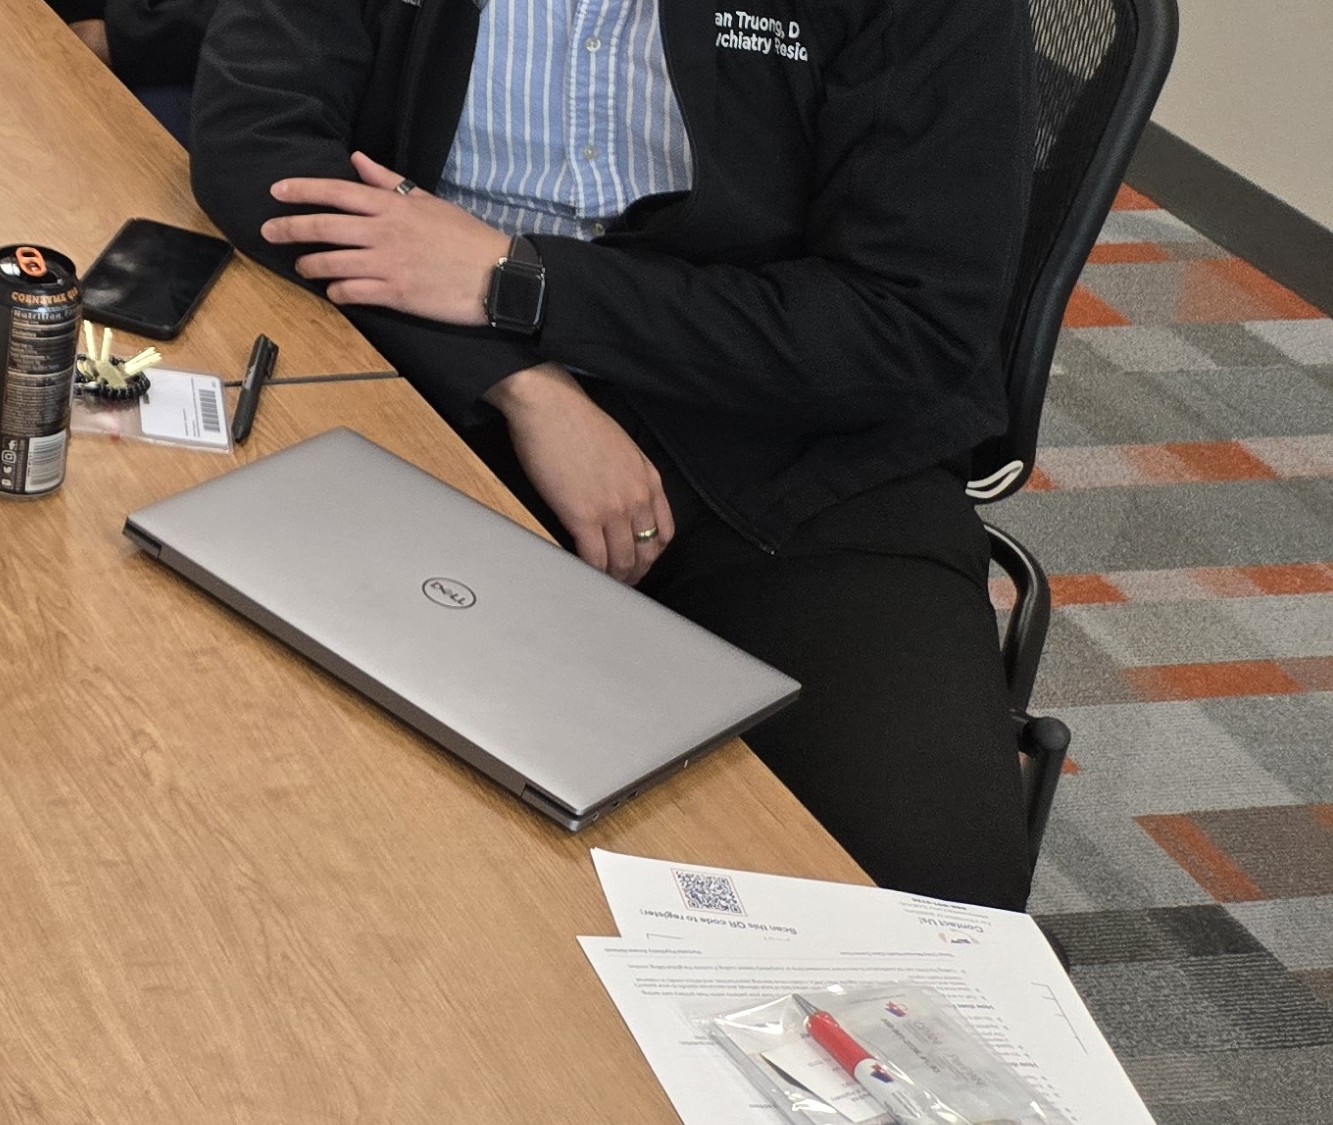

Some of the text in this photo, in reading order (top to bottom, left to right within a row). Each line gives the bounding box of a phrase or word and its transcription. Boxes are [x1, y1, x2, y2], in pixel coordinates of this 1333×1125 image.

[735, 10, 785, 39] Truong,
[637, 906, 797, 935] Scan this QR code to register:
[937, 919, 985, 933] Contact
